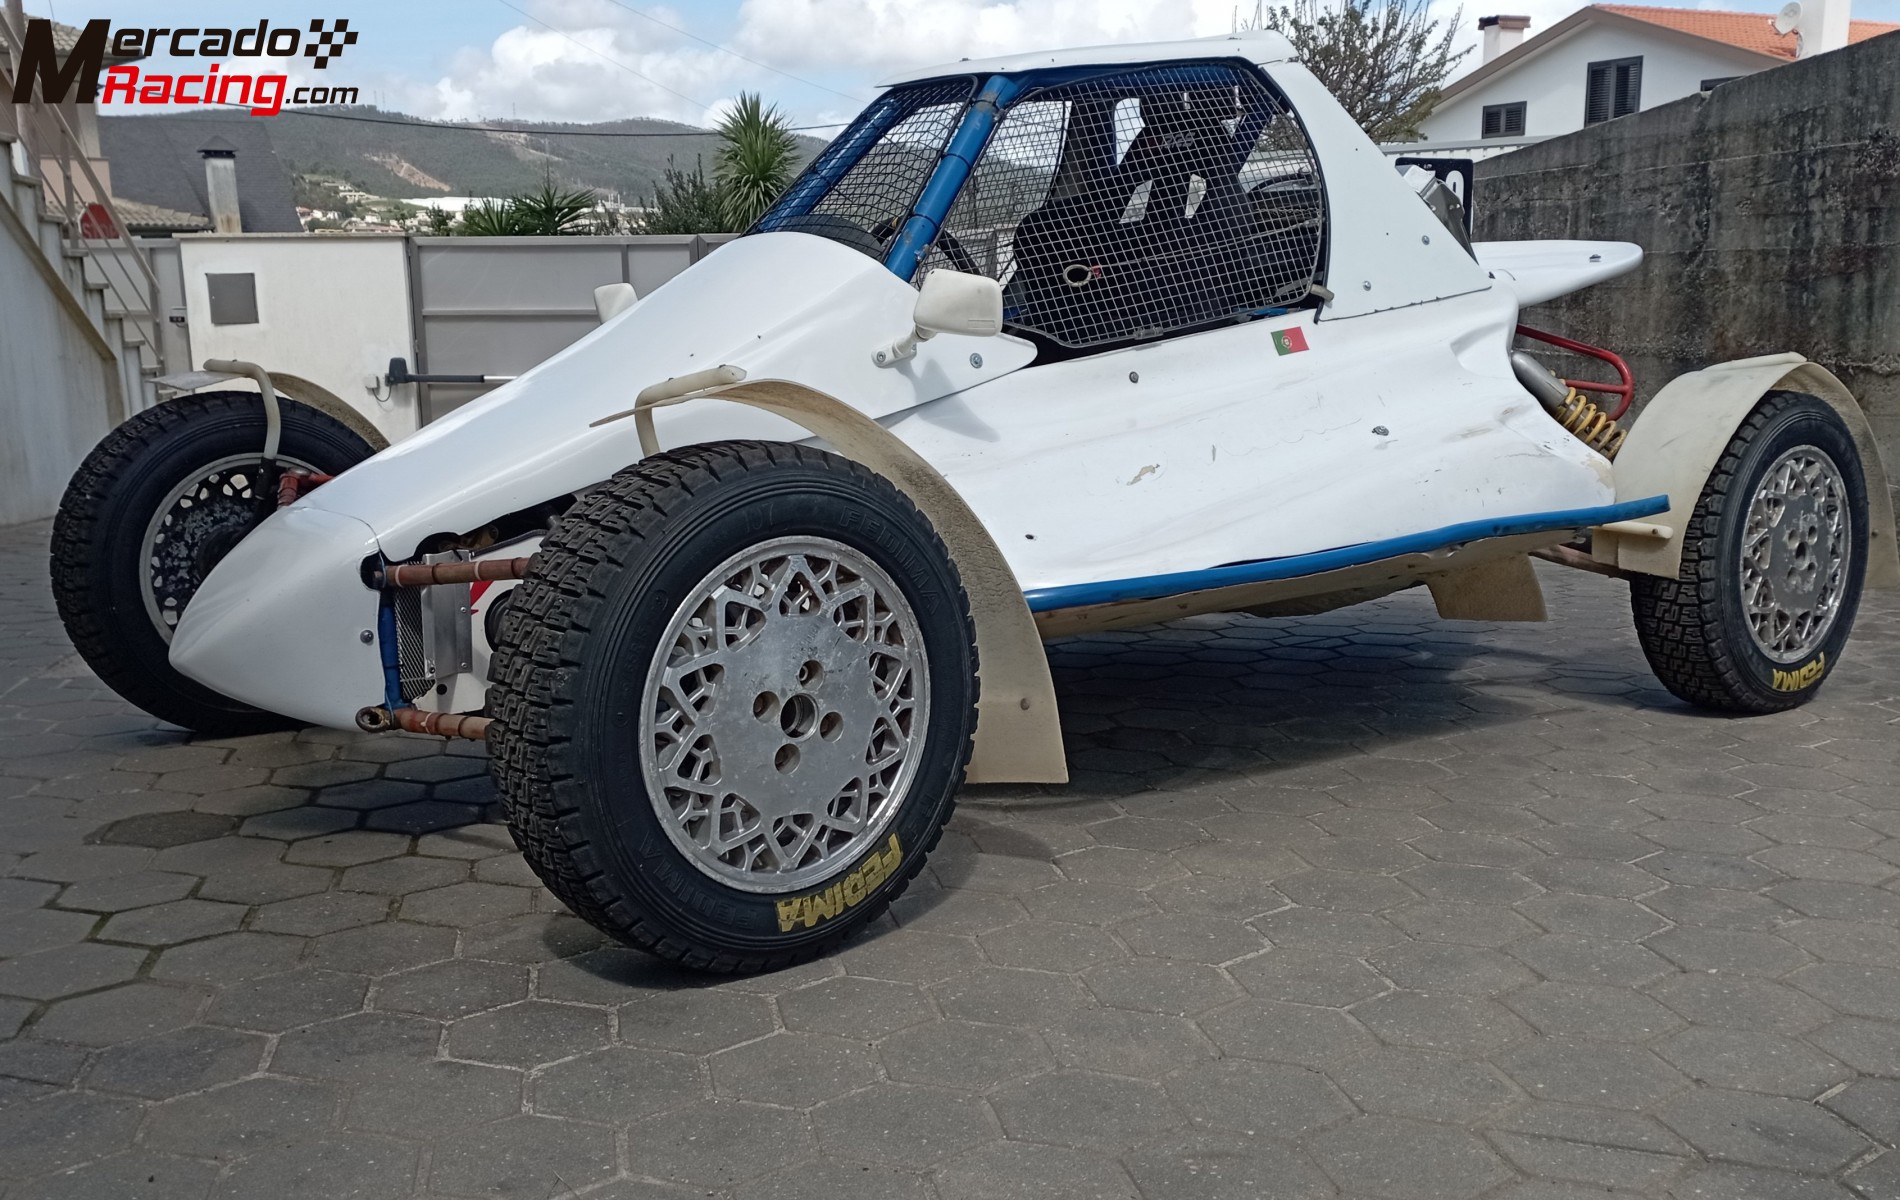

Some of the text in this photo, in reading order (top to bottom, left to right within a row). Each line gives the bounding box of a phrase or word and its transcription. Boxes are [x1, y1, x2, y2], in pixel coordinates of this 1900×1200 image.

[840, 505, 945, 616] FEDIMA
[1772, 651, 1825, 692] FEDIMA
[638, 829, 757, 930] FEDIMA
[777, 833, 903, 933] FEDIMA
